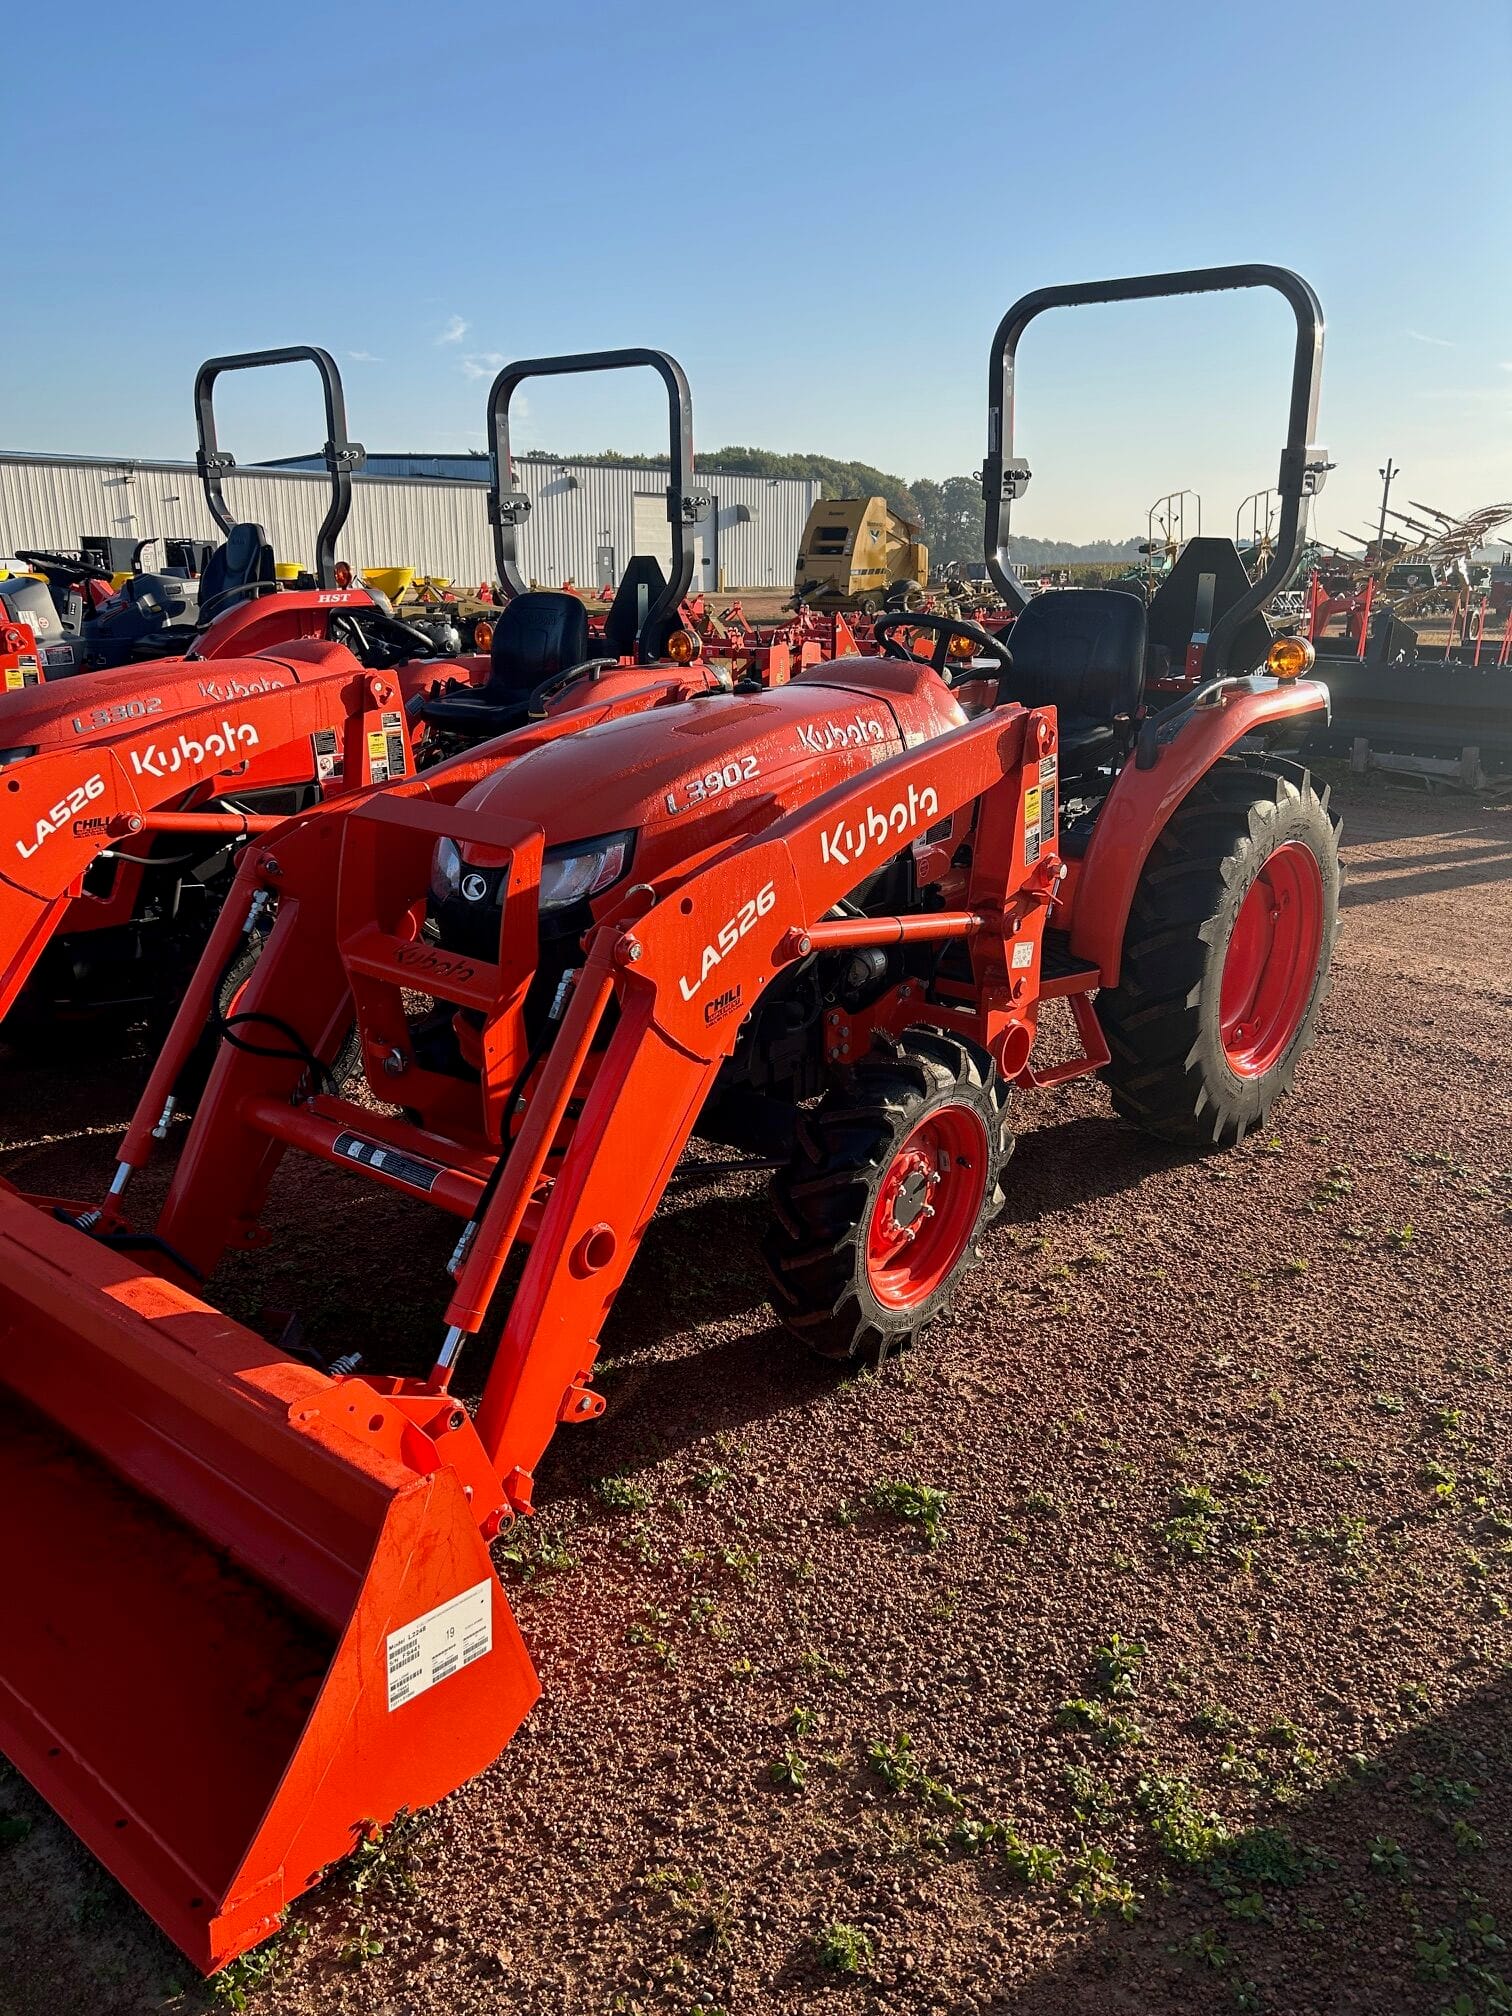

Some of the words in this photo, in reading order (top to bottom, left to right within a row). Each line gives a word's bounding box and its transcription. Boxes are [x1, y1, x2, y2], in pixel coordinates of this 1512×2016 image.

[318, 593, 351, 603] HST
[198, 677, 285, 700] Kubota
[73, 697, 162, 734] L3302
[797, 716, 883, 752] Kubota
[130, 720, 260, 777] Kubota
[667, 756, 760, 815] L3902
[15, 773, 107, 859] LA526
[73, 816, 111, 836] CHILI
[820, 784, 939, 866] Kubota
[679, 882, 776, 1001] LA526
[396, 944, 474, 981] Kubota
[704, 984, 741, 1024] CHILI
[446, 1627, 455, 1640] 19
